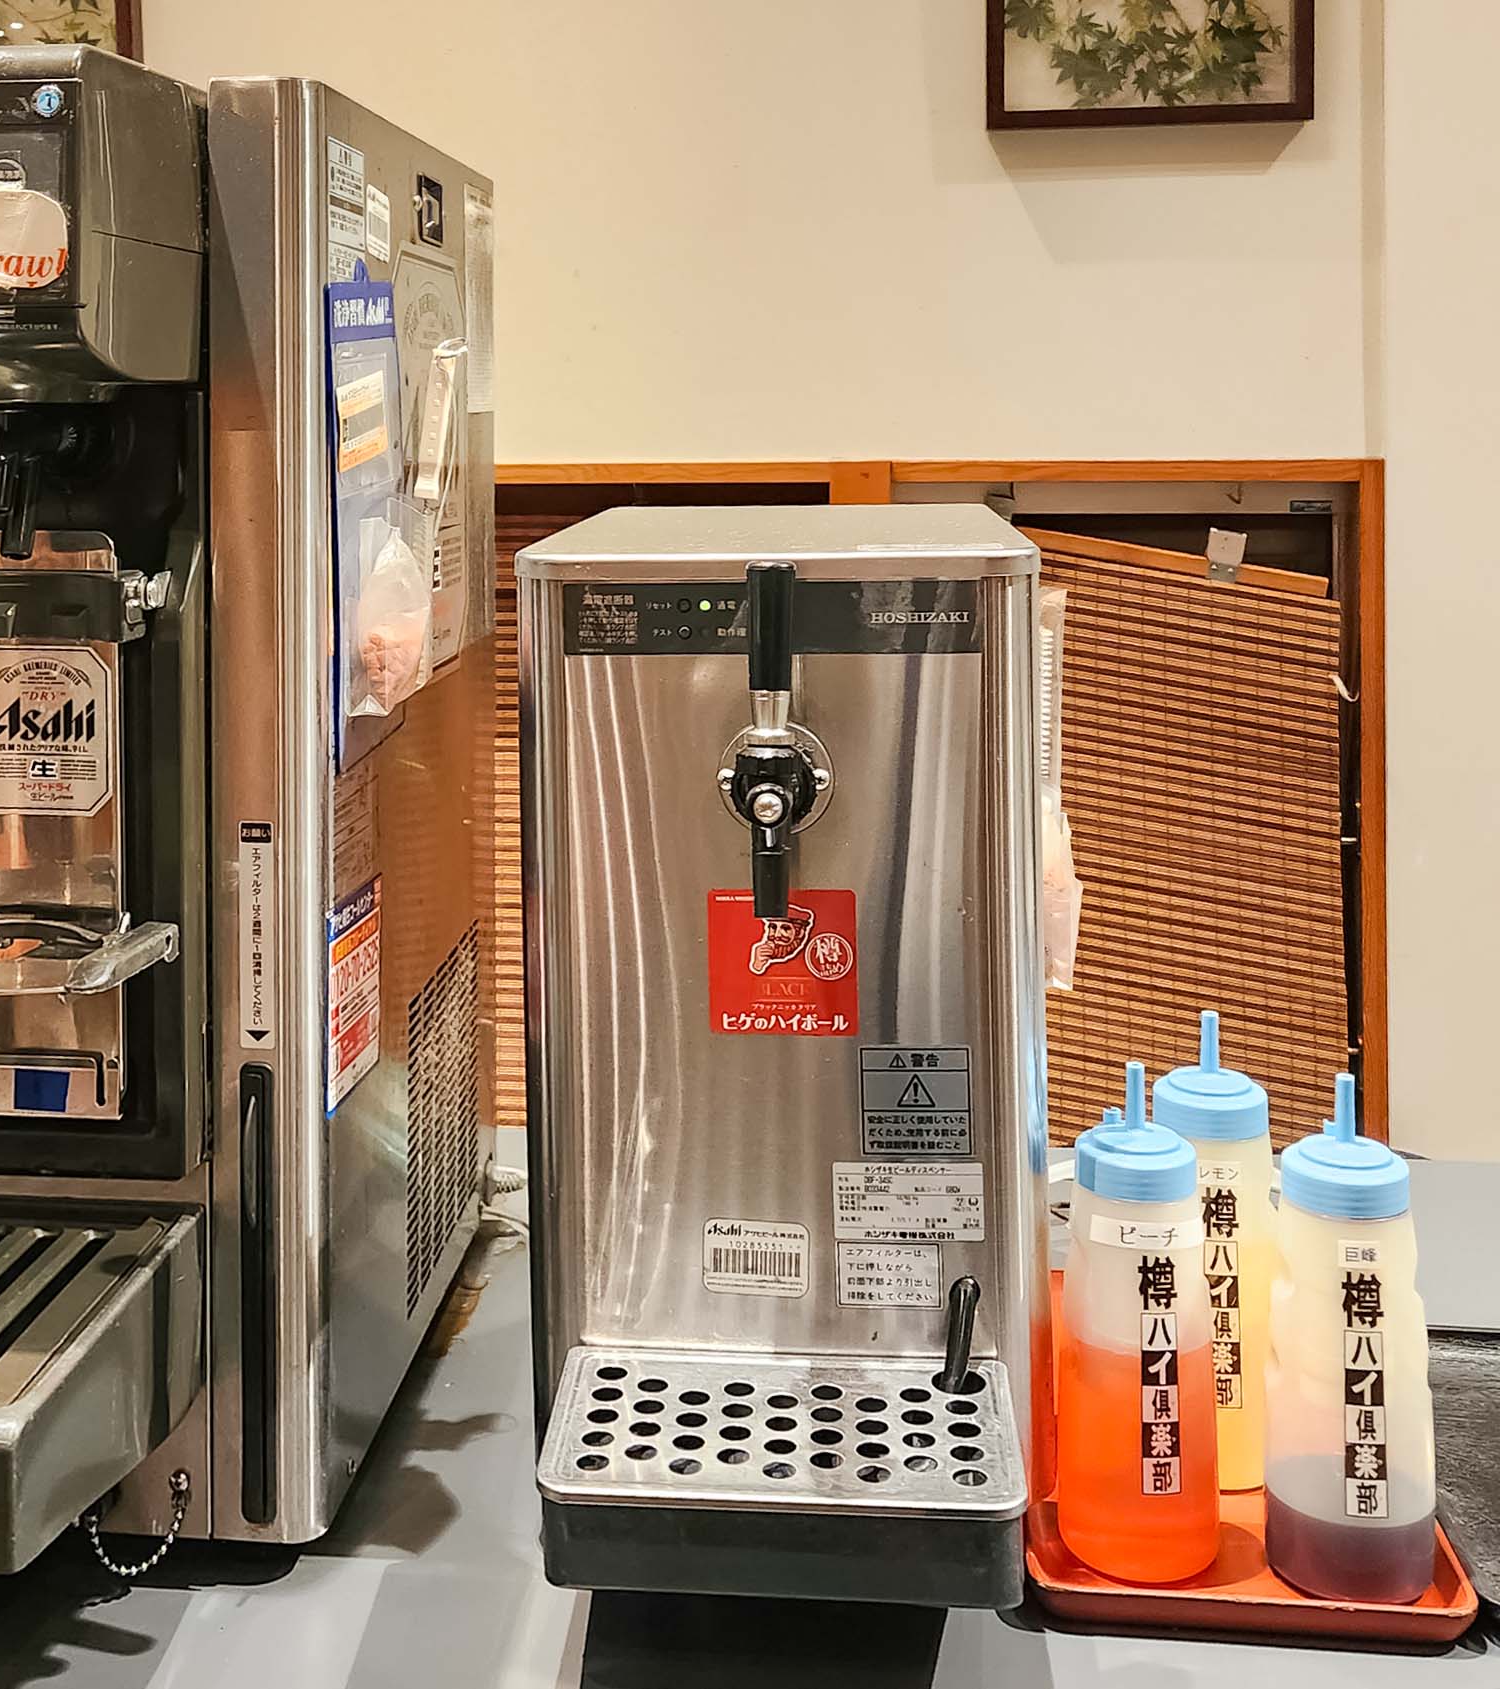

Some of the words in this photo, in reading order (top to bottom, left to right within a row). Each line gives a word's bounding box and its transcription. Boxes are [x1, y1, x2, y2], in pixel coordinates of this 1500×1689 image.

[645, 601, 672, 610] リセット
[870, 611, 970, 624] HOSHIZAKI
[651, 629, 673, 637] テスト
[31, 759, 58, 778] 生
[18, 781, 72, 792] スーパードライ
[241, 828, 271, 838] お願い
[721, 1012, 849, 1032] ヒゲのハイボール
[910, 1053, 940, 1068] 警告
[867, 1115, 967, 1125] 安全に正しく使用していた
[1197, 1165, 1240, 1182] レモン
[707, 1222, 742, 1237] Asahi
[1117, 1223, 1180, 1247] ピーチ
[845, 1248, 928, 1259] エアフィルターは、
[1344, 1247, 1377, 1263] 巨峰
[846, 1263, 914, 1272] 下に押しながら
[846, 1277, 933, 1288] 前面下部より引出し
